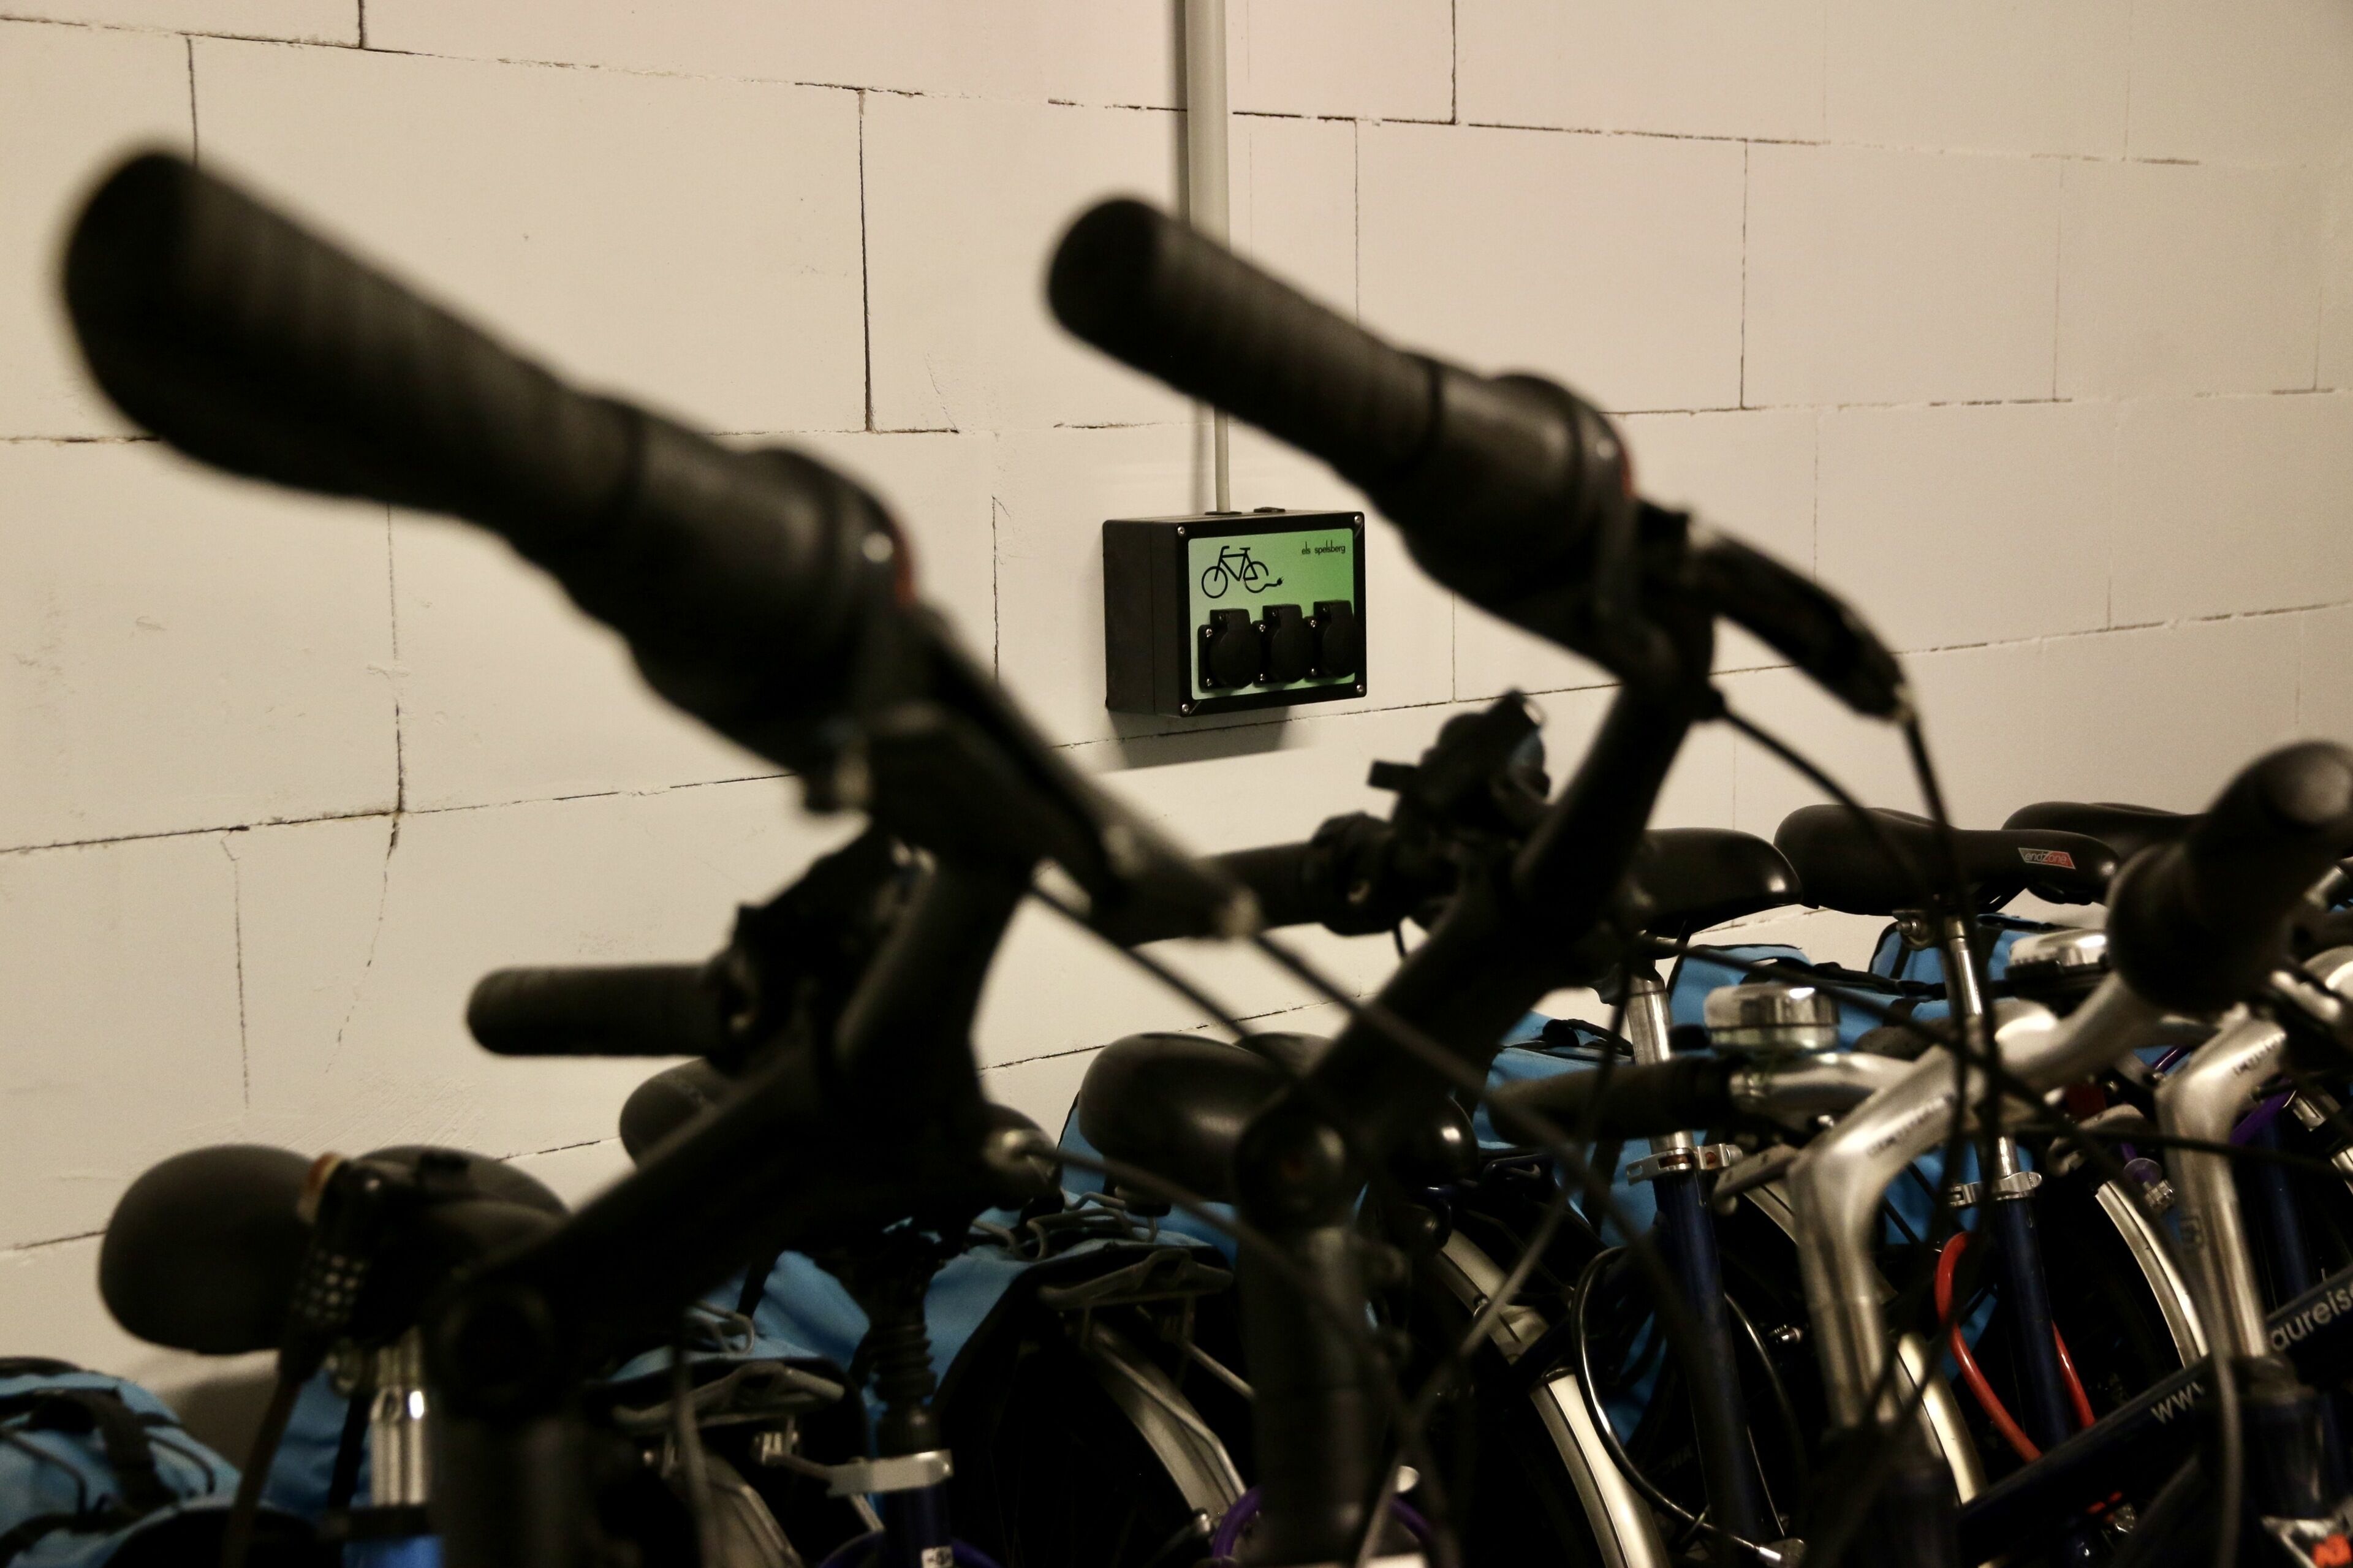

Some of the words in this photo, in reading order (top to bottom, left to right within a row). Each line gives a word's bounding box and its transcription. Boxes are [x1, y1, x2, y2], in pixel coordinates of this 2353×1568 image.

[1302, 541, 1311, 555] els
[1314, 539, 1346, 555] spelsberg
[2270, 1279, 2353, 1352] aurels
